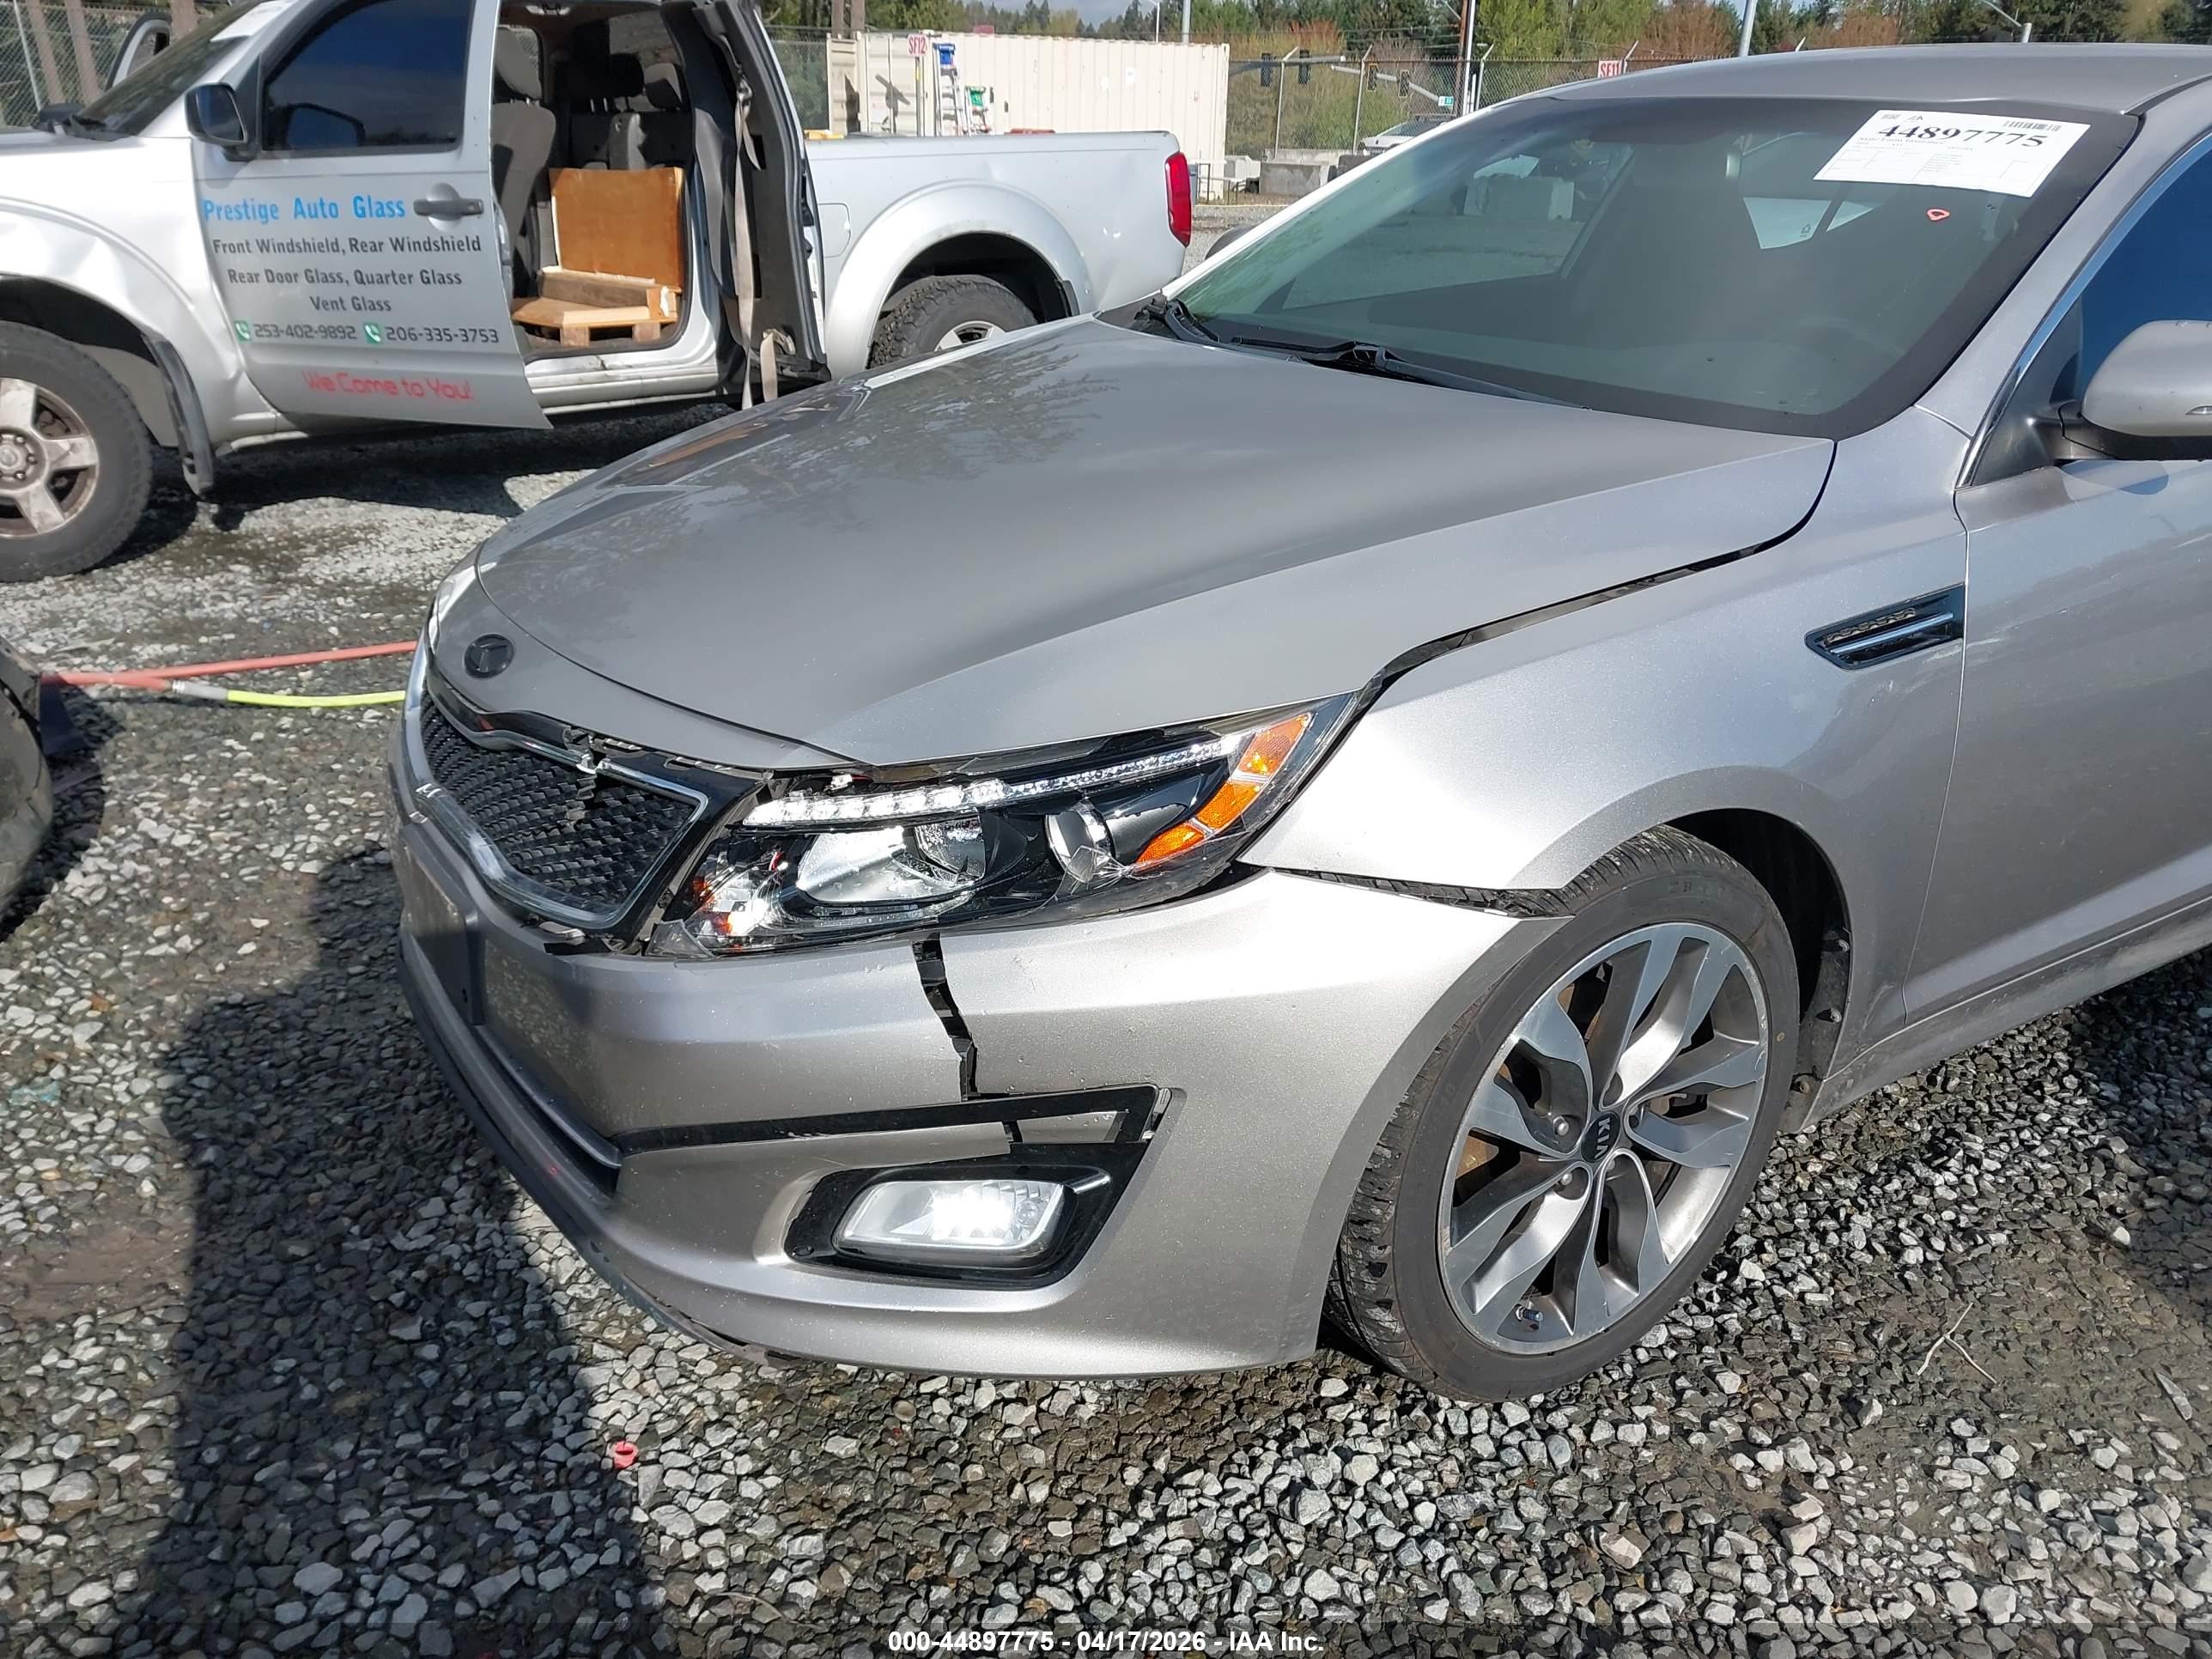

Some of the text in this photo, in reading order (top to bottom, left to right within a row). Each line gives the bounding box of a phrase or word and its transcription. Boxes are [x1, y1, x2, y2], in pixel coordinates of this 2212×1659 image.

[908, 37, 927, 54] SF12
[1878, 125, 2048, 148] 44897775
[202, 195, 405, 225] Prestige Auto Glass
[213, 234, 482, 255] Front Windshield, Rear Windshield
[228, 268, 462, 286] Rear Door Glass, Quarter Glass
[309, 296, 392, 312] Vent Glass
[253, 323, 500, 343] 253-402-9892 206-335-3753
[301, 370, 337, 392] We
[336, 371, 399, 396] Come
[400, 376, 425, 398] to
[1594, 1116, 1611, 1159] KIA
